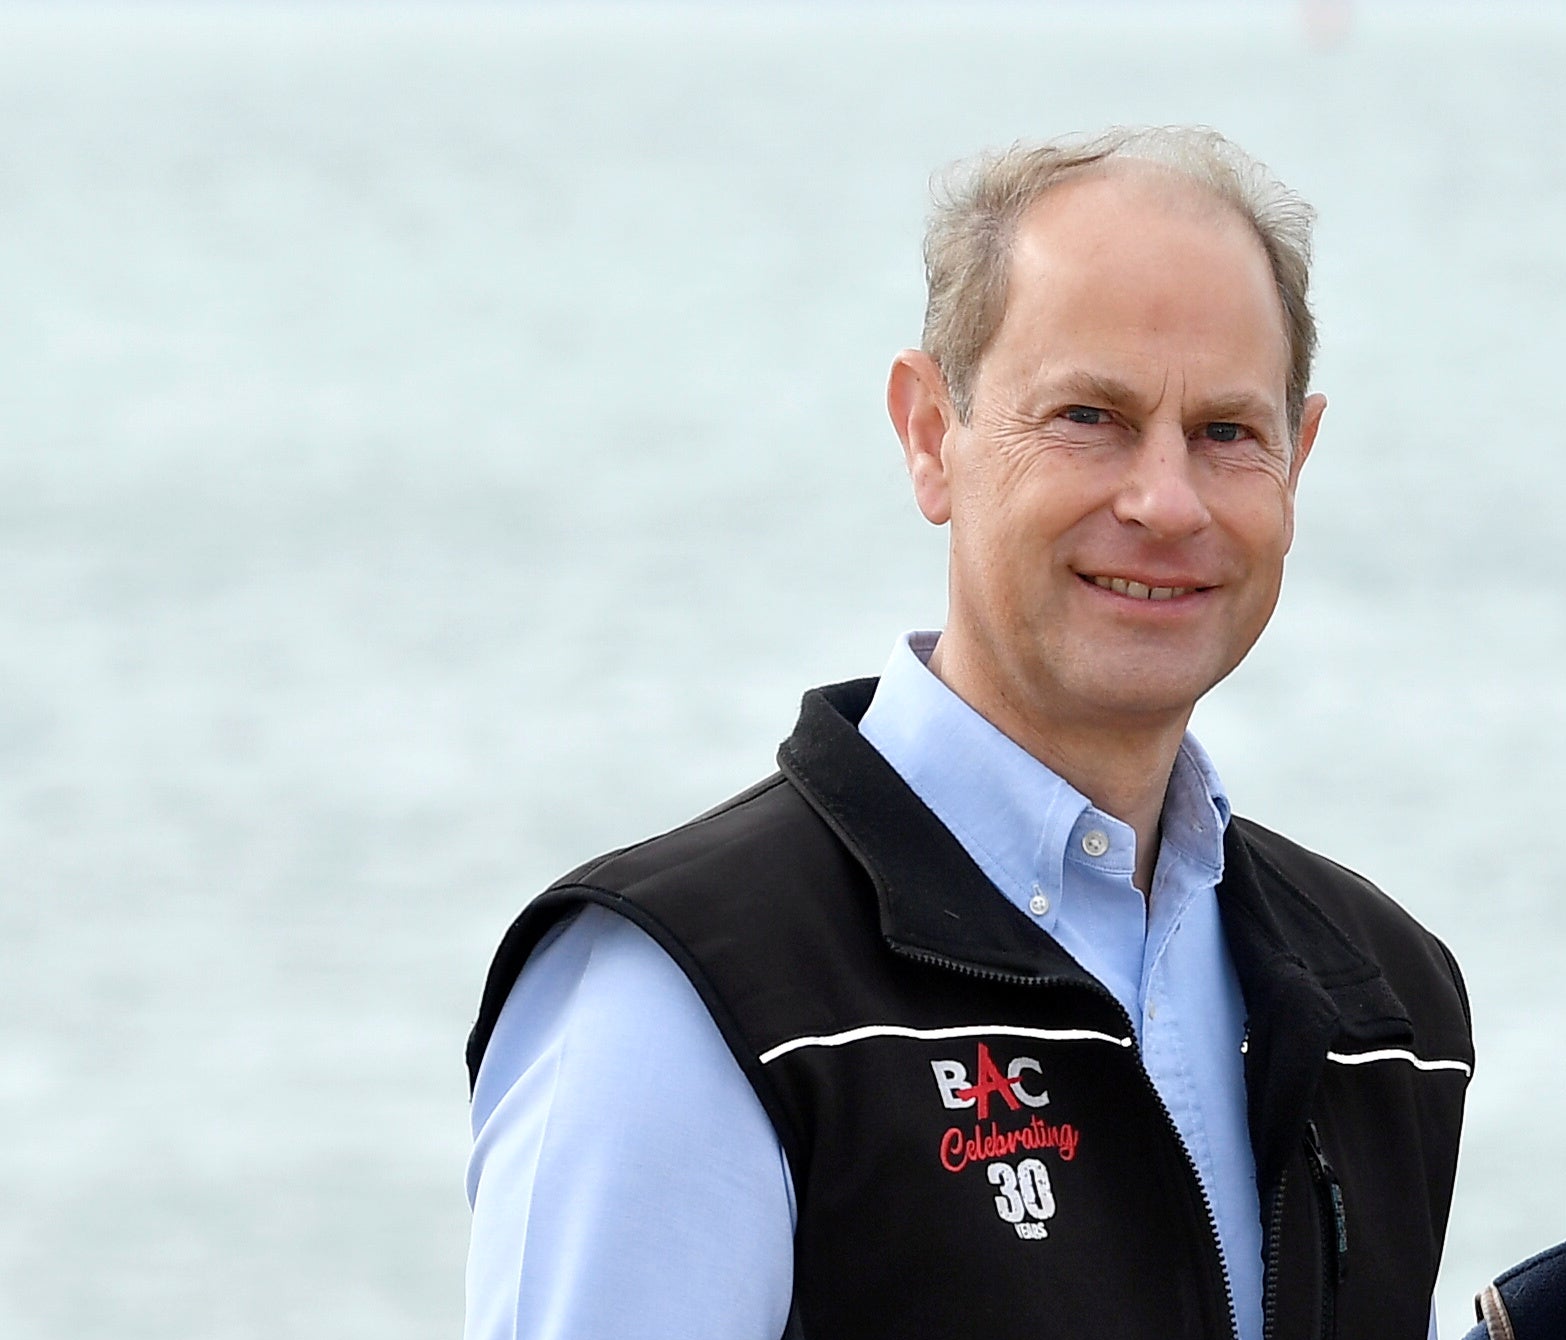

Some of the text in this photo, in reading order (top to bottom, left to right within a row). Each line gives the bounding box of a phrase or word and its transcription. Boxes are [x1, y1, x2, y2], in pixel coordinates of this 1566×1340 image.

[931, 1042, 1050, 1120] BAC
[940, 1114, 1080, 1173] Celebrating
[987, 1158, 1056, 1223] 30
